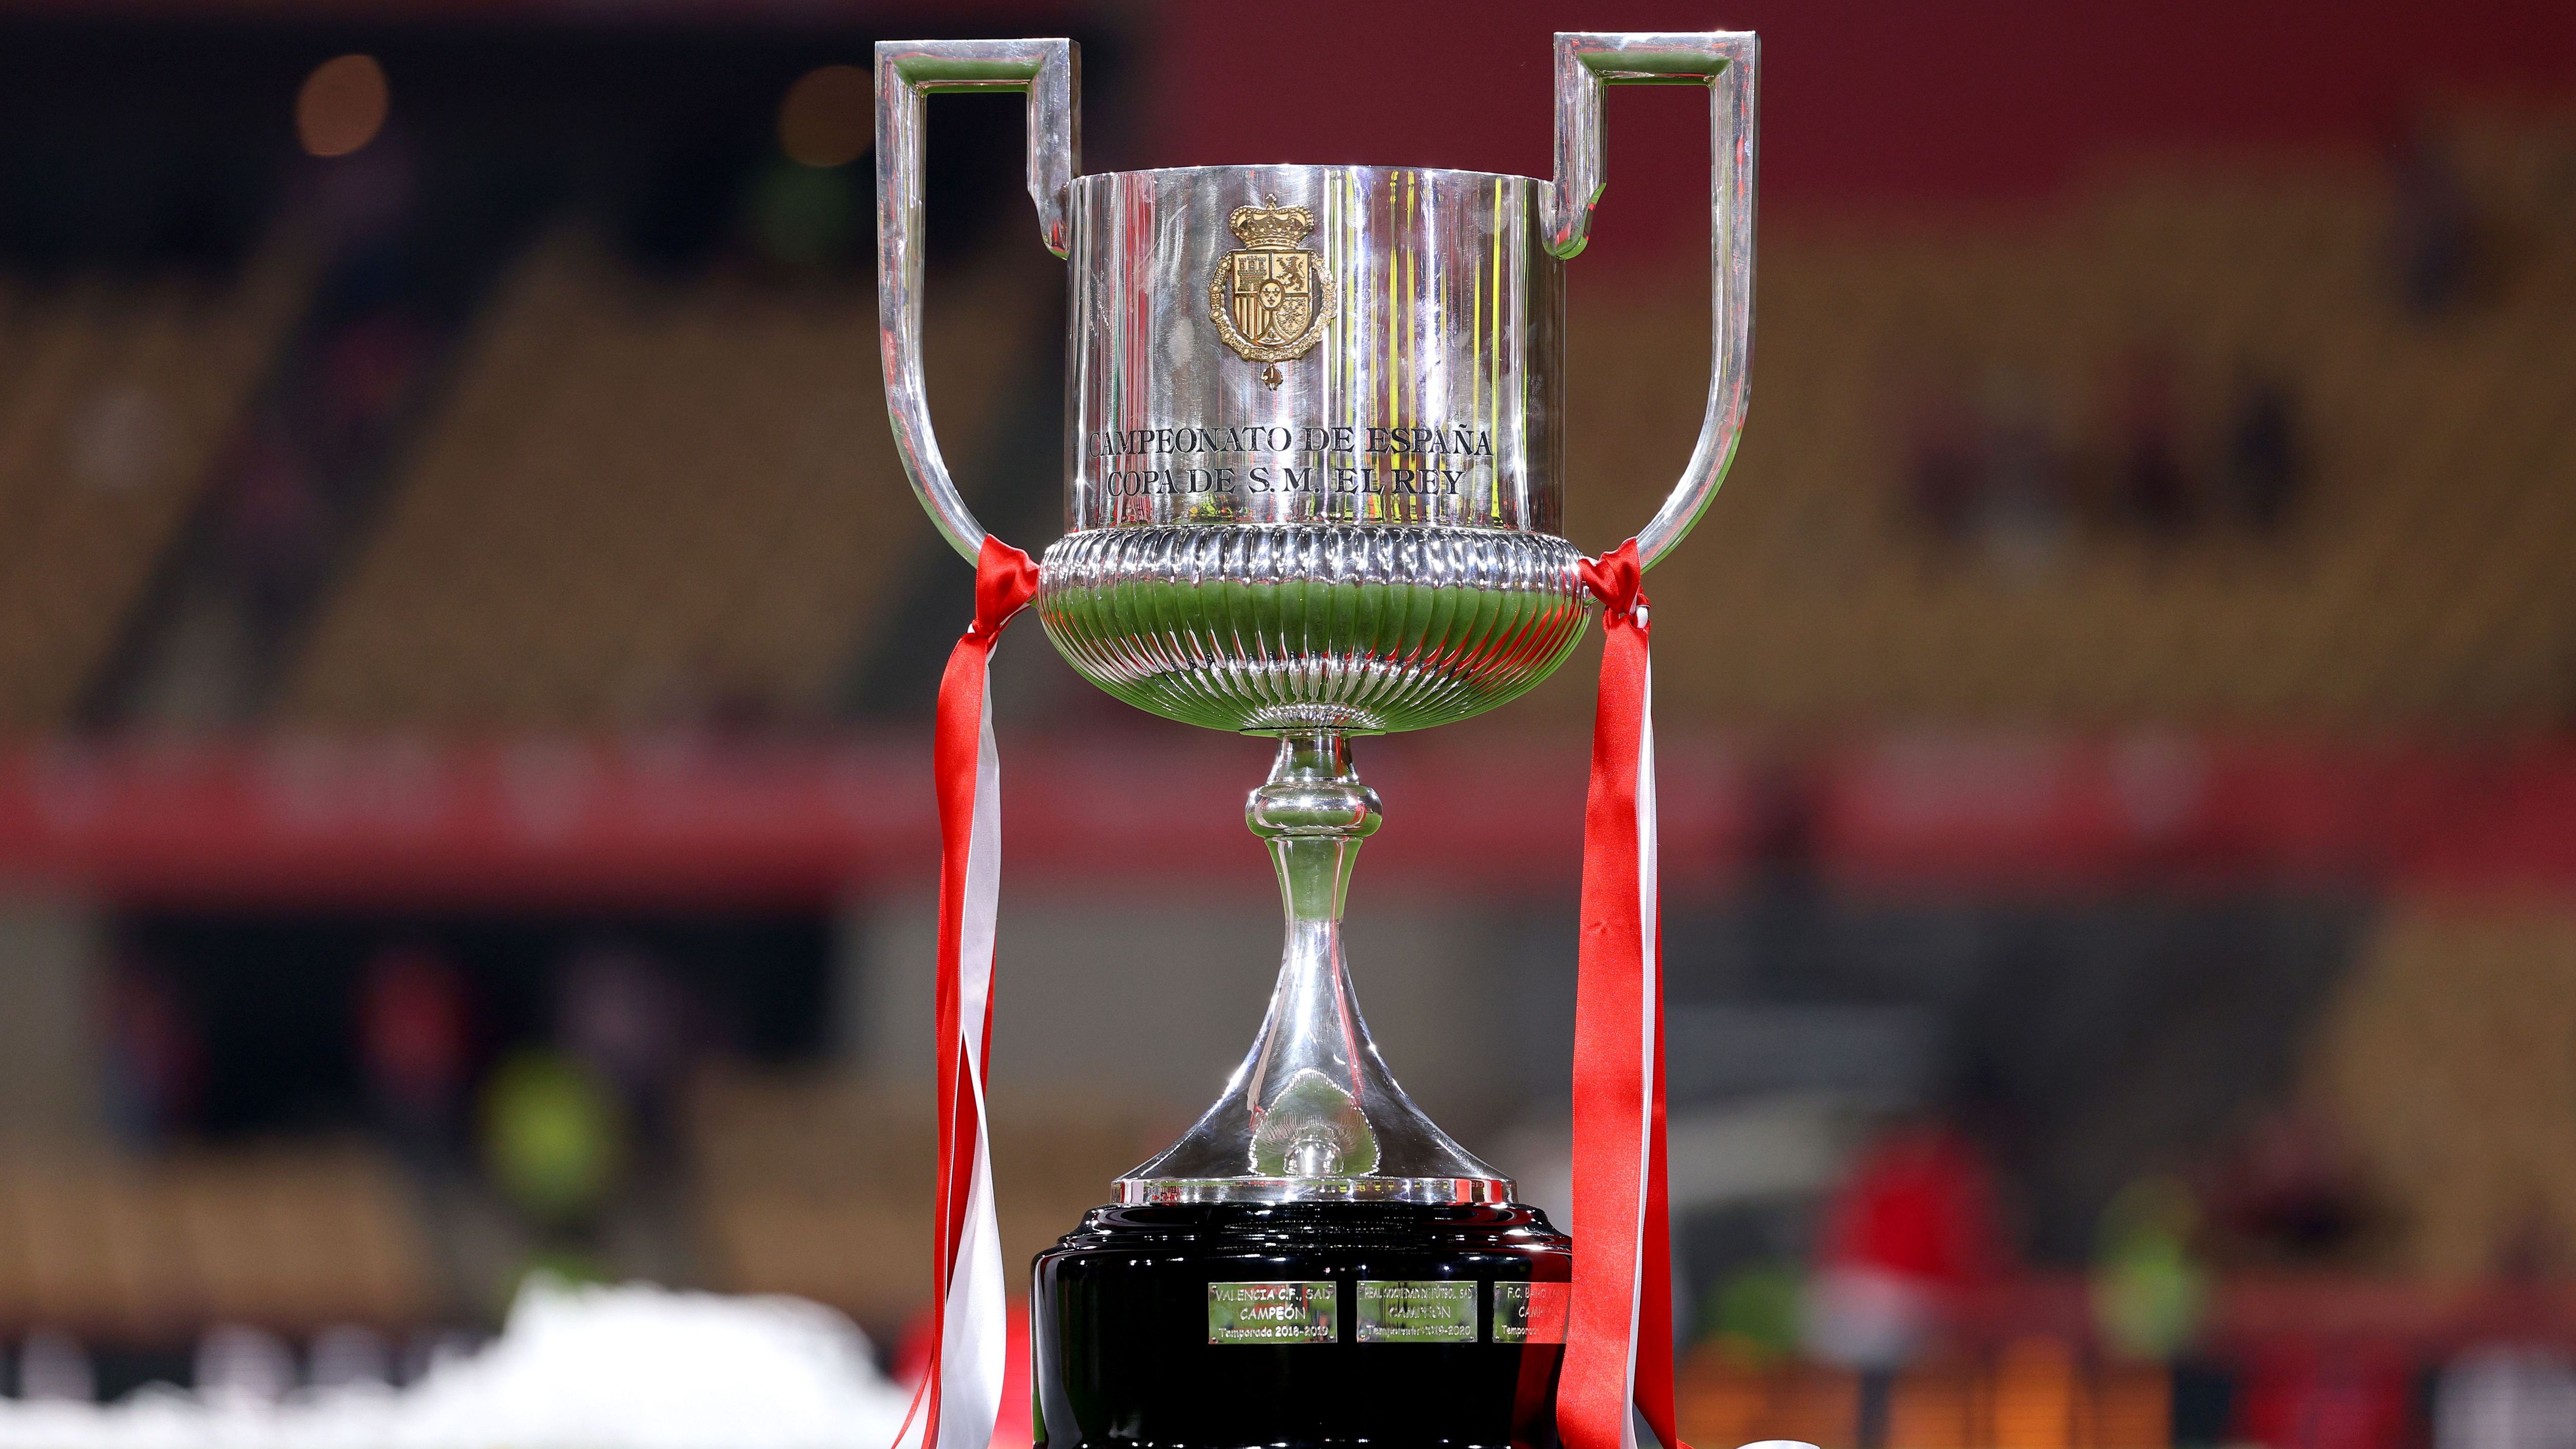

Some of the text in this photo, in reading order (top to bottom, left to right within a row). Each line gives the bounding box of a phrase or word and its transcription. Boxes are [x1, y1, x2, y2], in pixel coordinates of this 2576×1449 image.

[1089, 424, 1493, 458] CAMPEONATO DE ESPAÑA
[1107, 469, 1179, 497] COPA
[1187, 468, 1235, 494] DE
[1334, 468, 1385, 494] EL
[1391, 469, 1466, 495] REY
[1215, 1288, 1275, 1301] VALENCIA
[1306, 1288, 1330, 1300] SAD
[1365, 1287, 1382, 1299] REAL
[1460, 1288, 1472, 1299] SAD
[1507, 1287, 1522, 1299] F.C.
[1240, 1303, 1307, 1320] CAMPEÓN
[1219, 1326, 1329, 1340] Temporada 2018-2019
